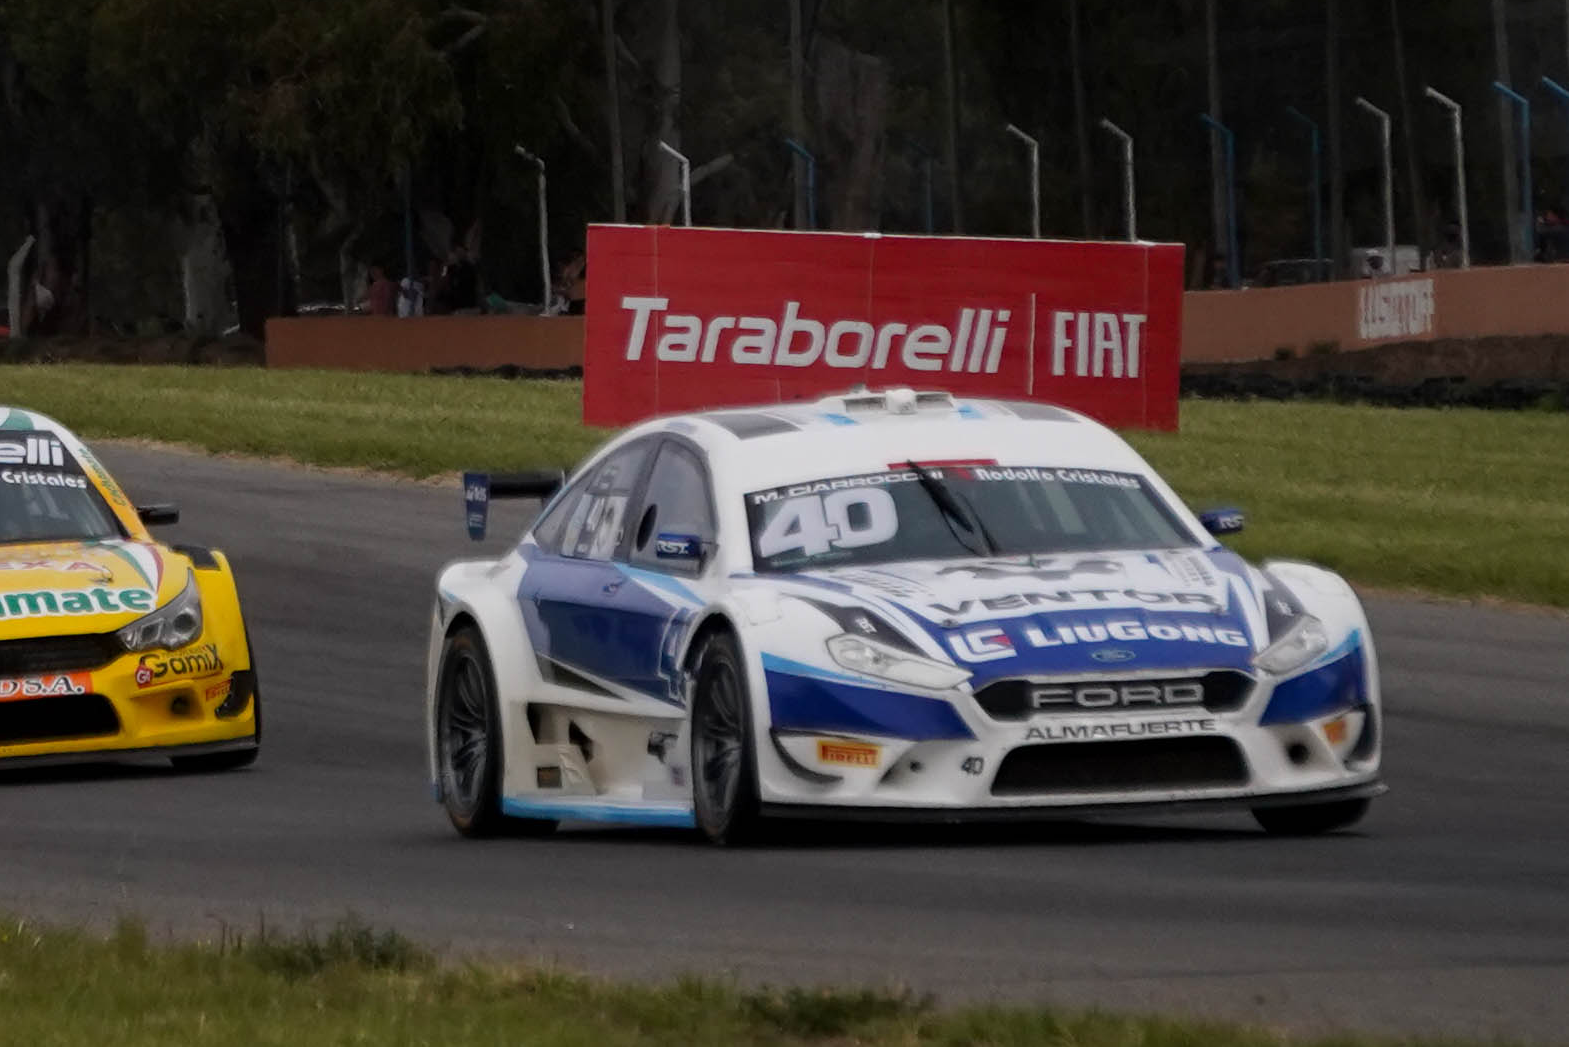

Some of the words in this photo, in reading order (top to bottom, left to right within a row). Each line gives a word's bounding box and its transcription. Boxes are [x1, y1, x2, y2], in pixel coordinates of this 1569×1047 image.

[620, 296, 1011, 374] Taraborelli
[1050, 310, 1148, 378] FIAT
[1, 470, 87, 489] Cristales
[788, 470, 944, 498] CIARROCCI
[975, 467, 1055, 482] Rodolfo
[1057, 468, 1142, 490] Cristales
[759, 487, 899, 558] 40
[929, 589, 1221, 615] VENTOR
[1032, 681, 1205, 710] FORD
[1024, 718, 1218, 742] ALMAFUERTE
